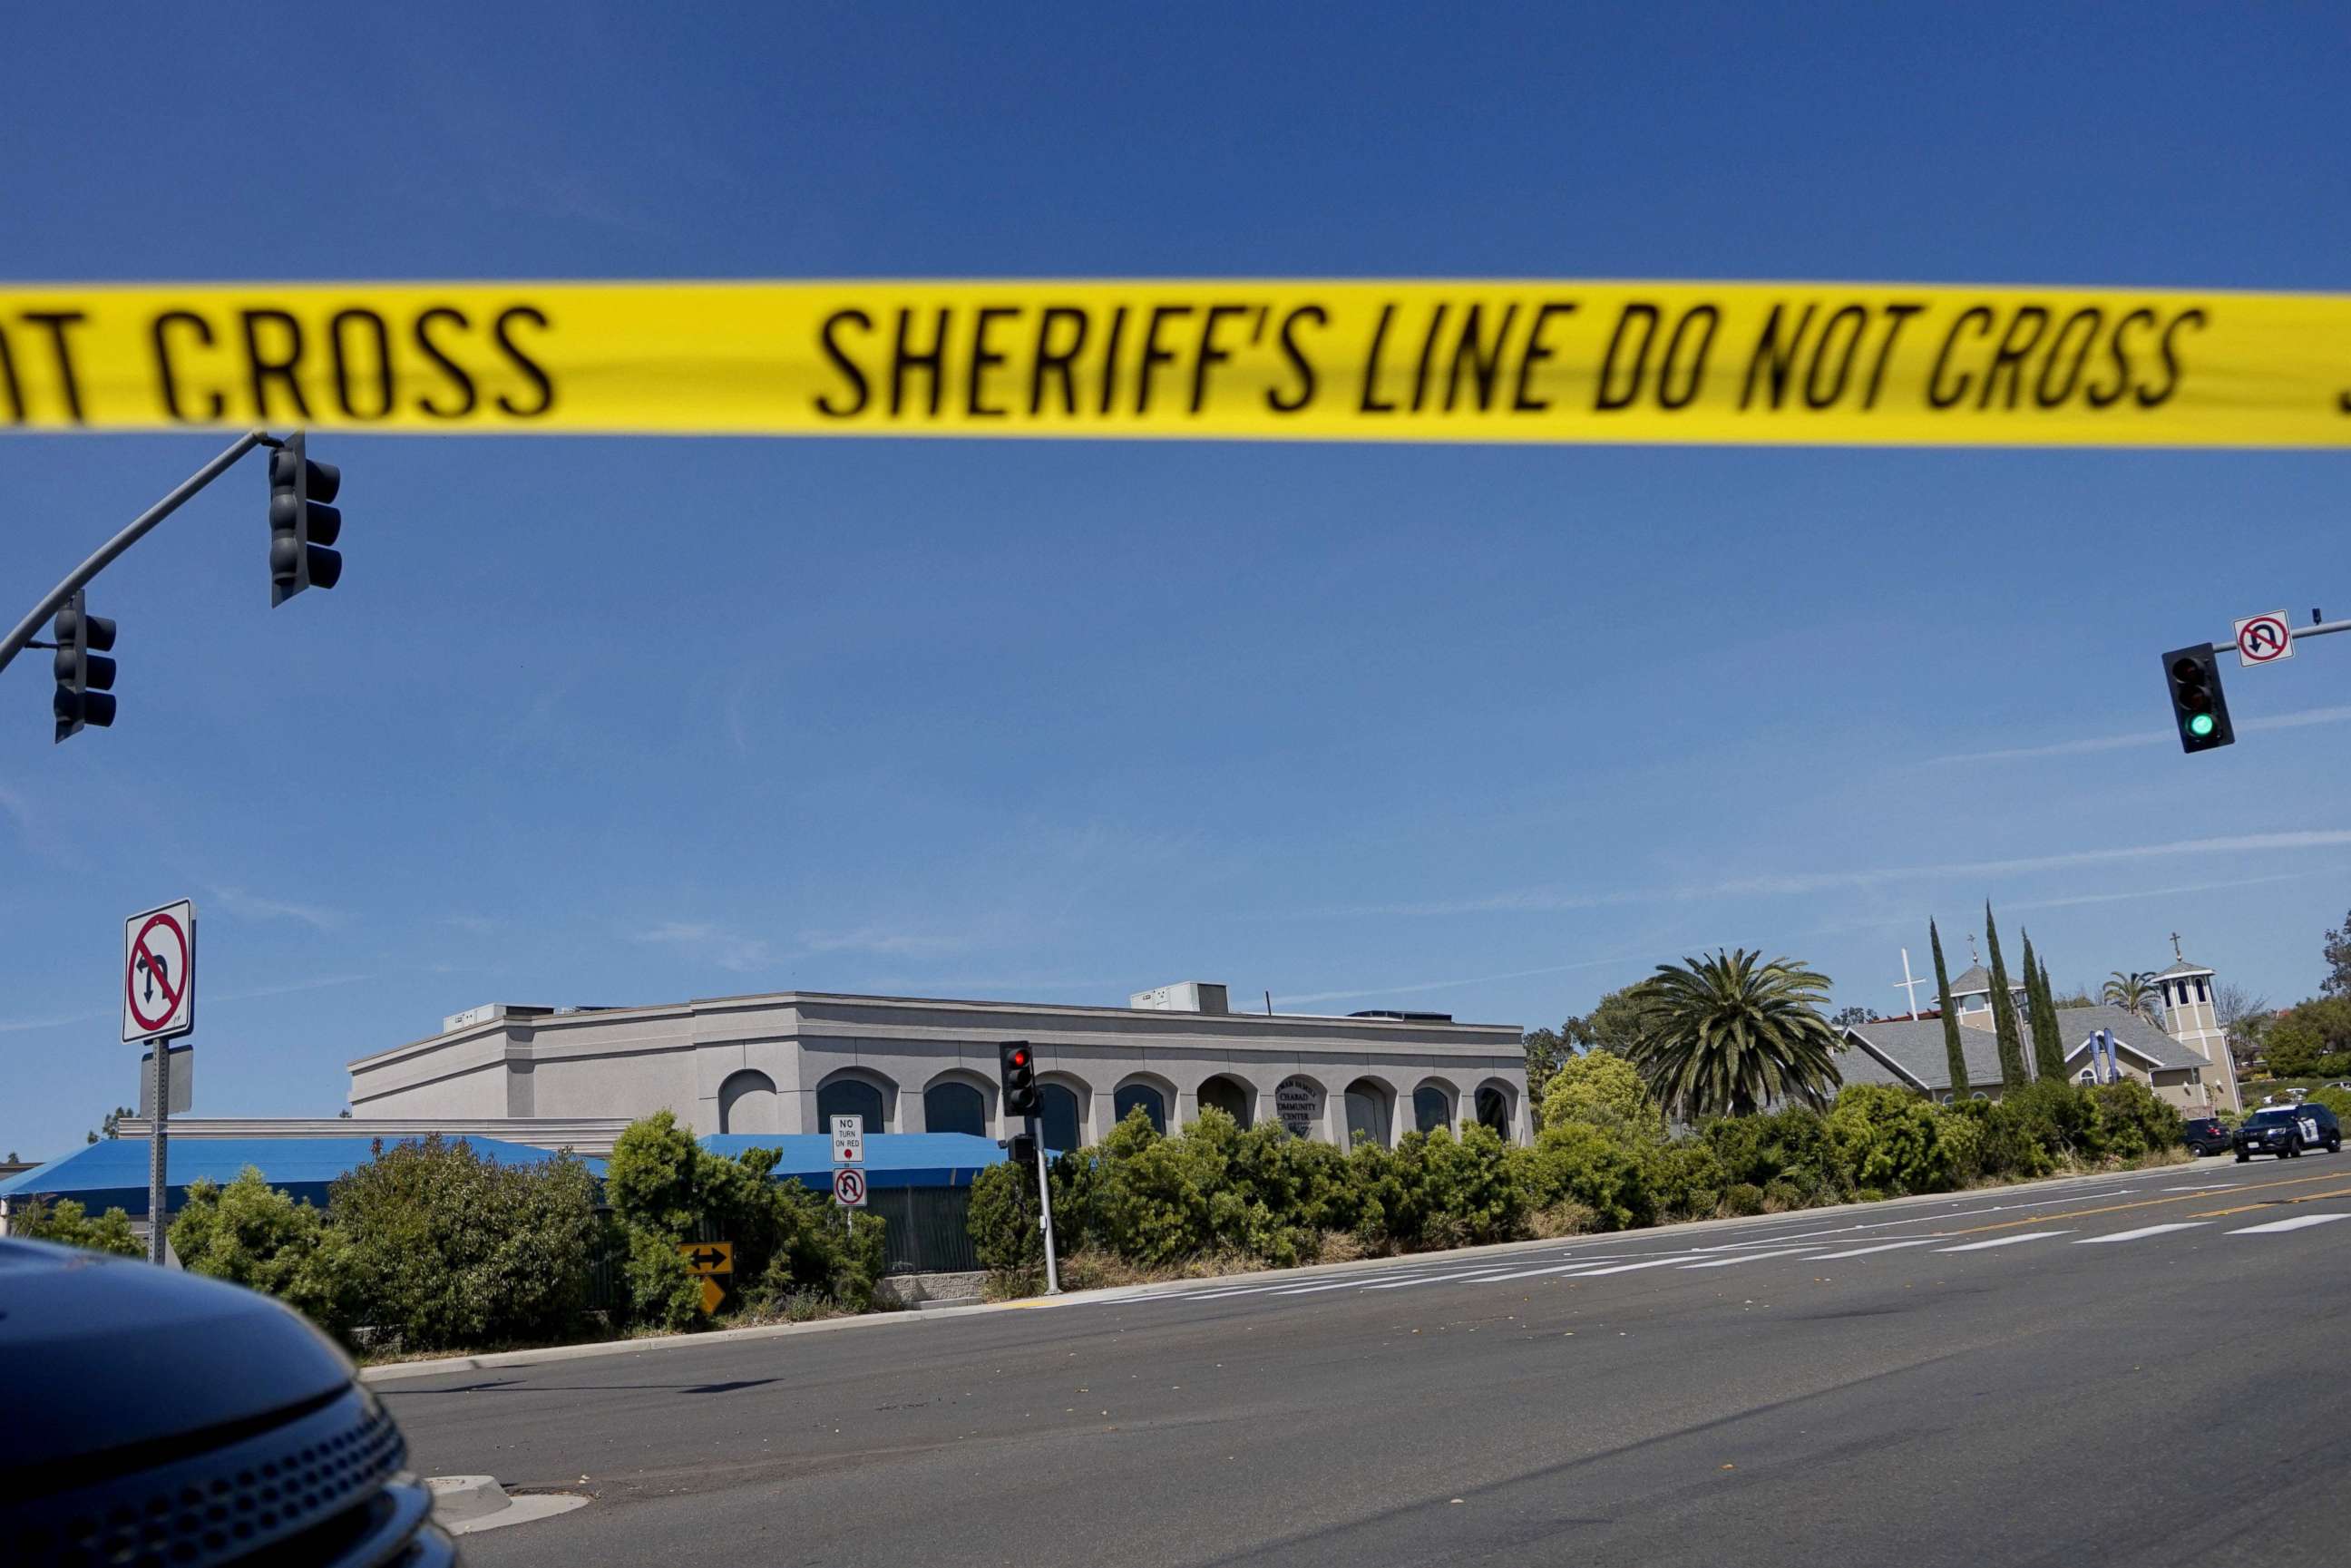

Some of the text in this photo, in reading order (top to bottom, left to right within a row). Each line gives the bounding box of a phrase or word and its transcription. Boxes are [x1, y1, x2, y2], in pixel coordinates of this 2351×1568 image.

[151, 305, 554, 420] CROSS
[815, 303, 2206, 417] SHERIFF'S LINE DO NOT CROSS
[840, 1119, 854, 1128] NO
[1280, 1093, 1308, 1101] CHABAD
